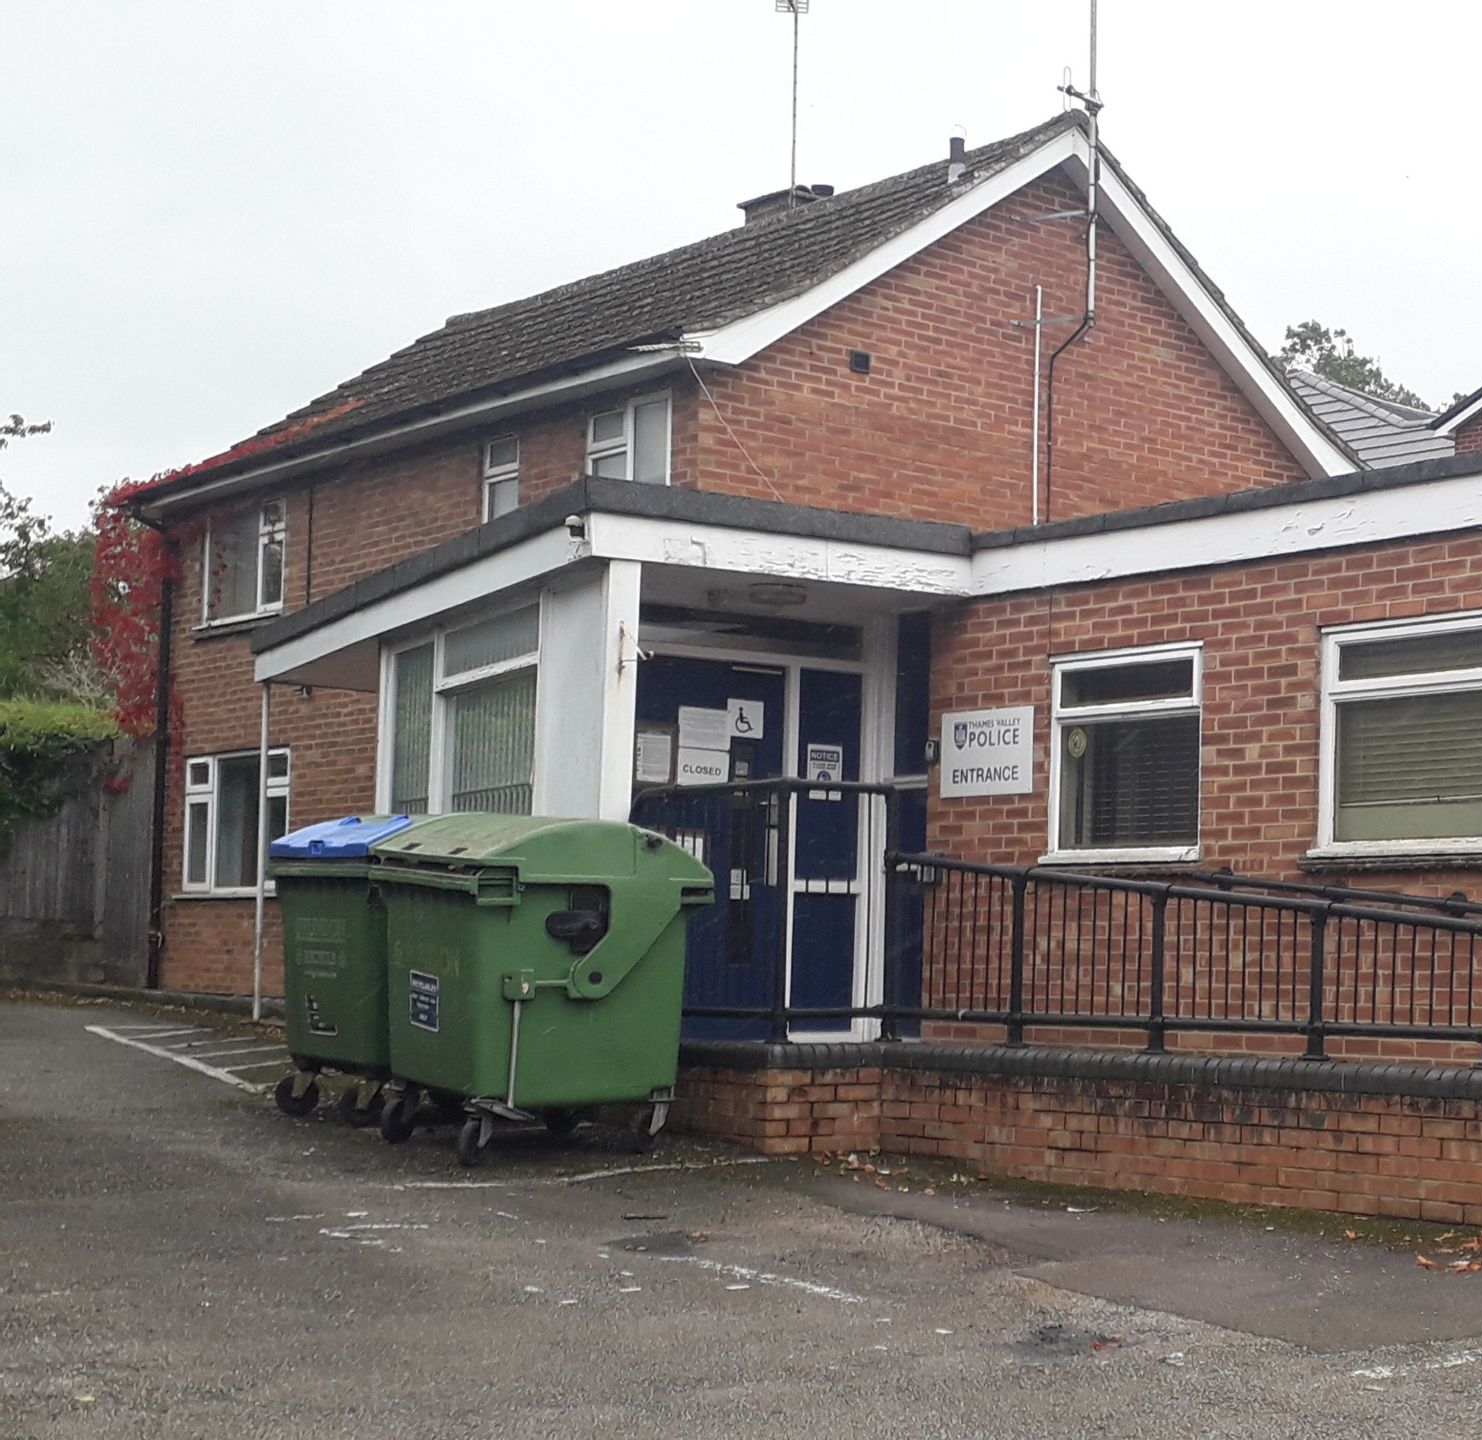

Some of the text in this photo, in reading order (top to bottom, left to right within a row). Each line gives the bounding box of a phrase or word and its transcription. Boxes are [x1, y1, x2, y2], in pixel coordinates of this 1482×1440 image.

[969, 718, 1020, 729] THAMES VALLEY
[969, 728, 1019, 748] POLICE
[811, 751, 839, 761] NOTICE
[682, 764, 722, 777] CLOSED
[952, 765, 1019, 784] ENTRANCE
